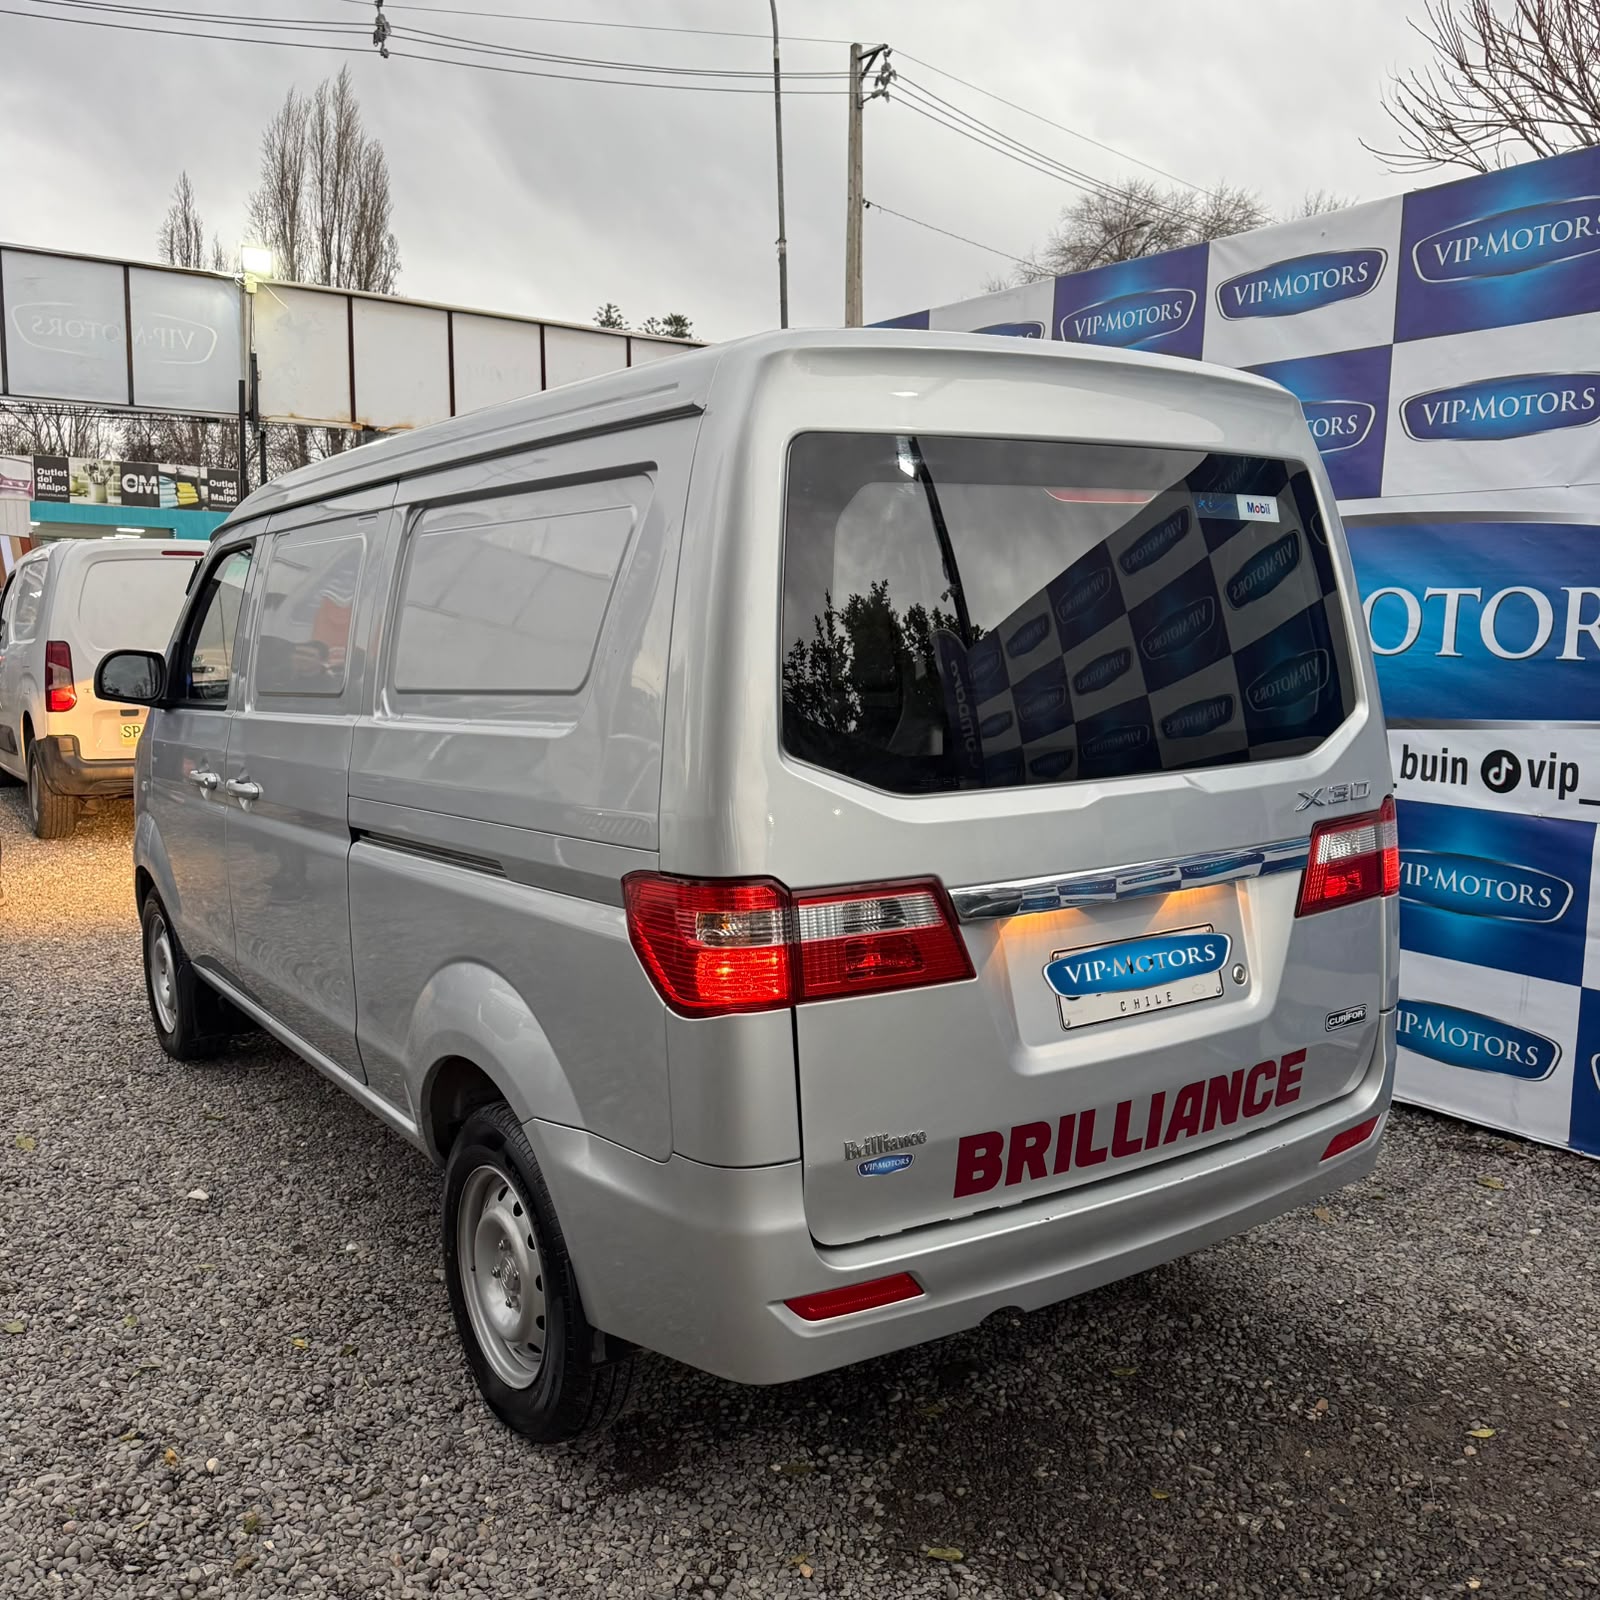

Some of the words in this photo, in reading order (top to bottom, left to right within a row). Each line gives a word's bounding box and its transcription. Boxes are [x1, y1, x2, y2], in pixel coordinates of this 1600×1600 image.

[37, 468, 68, 477] Outlet
[37, 482, 68, 493] Maipo
[209, 480, 237, 488] Outlet
[210, 494, 238, 503] Maipo
[1246, 501, 1271, 515] Mobil
[1295, 780, 1371, 812] X30
[1120, 991, 1173, 1012] CHILE
[953, 1048, 1307, 1199] BRILLIANCE
[844, 1130, 928, 1161] Brilliance
